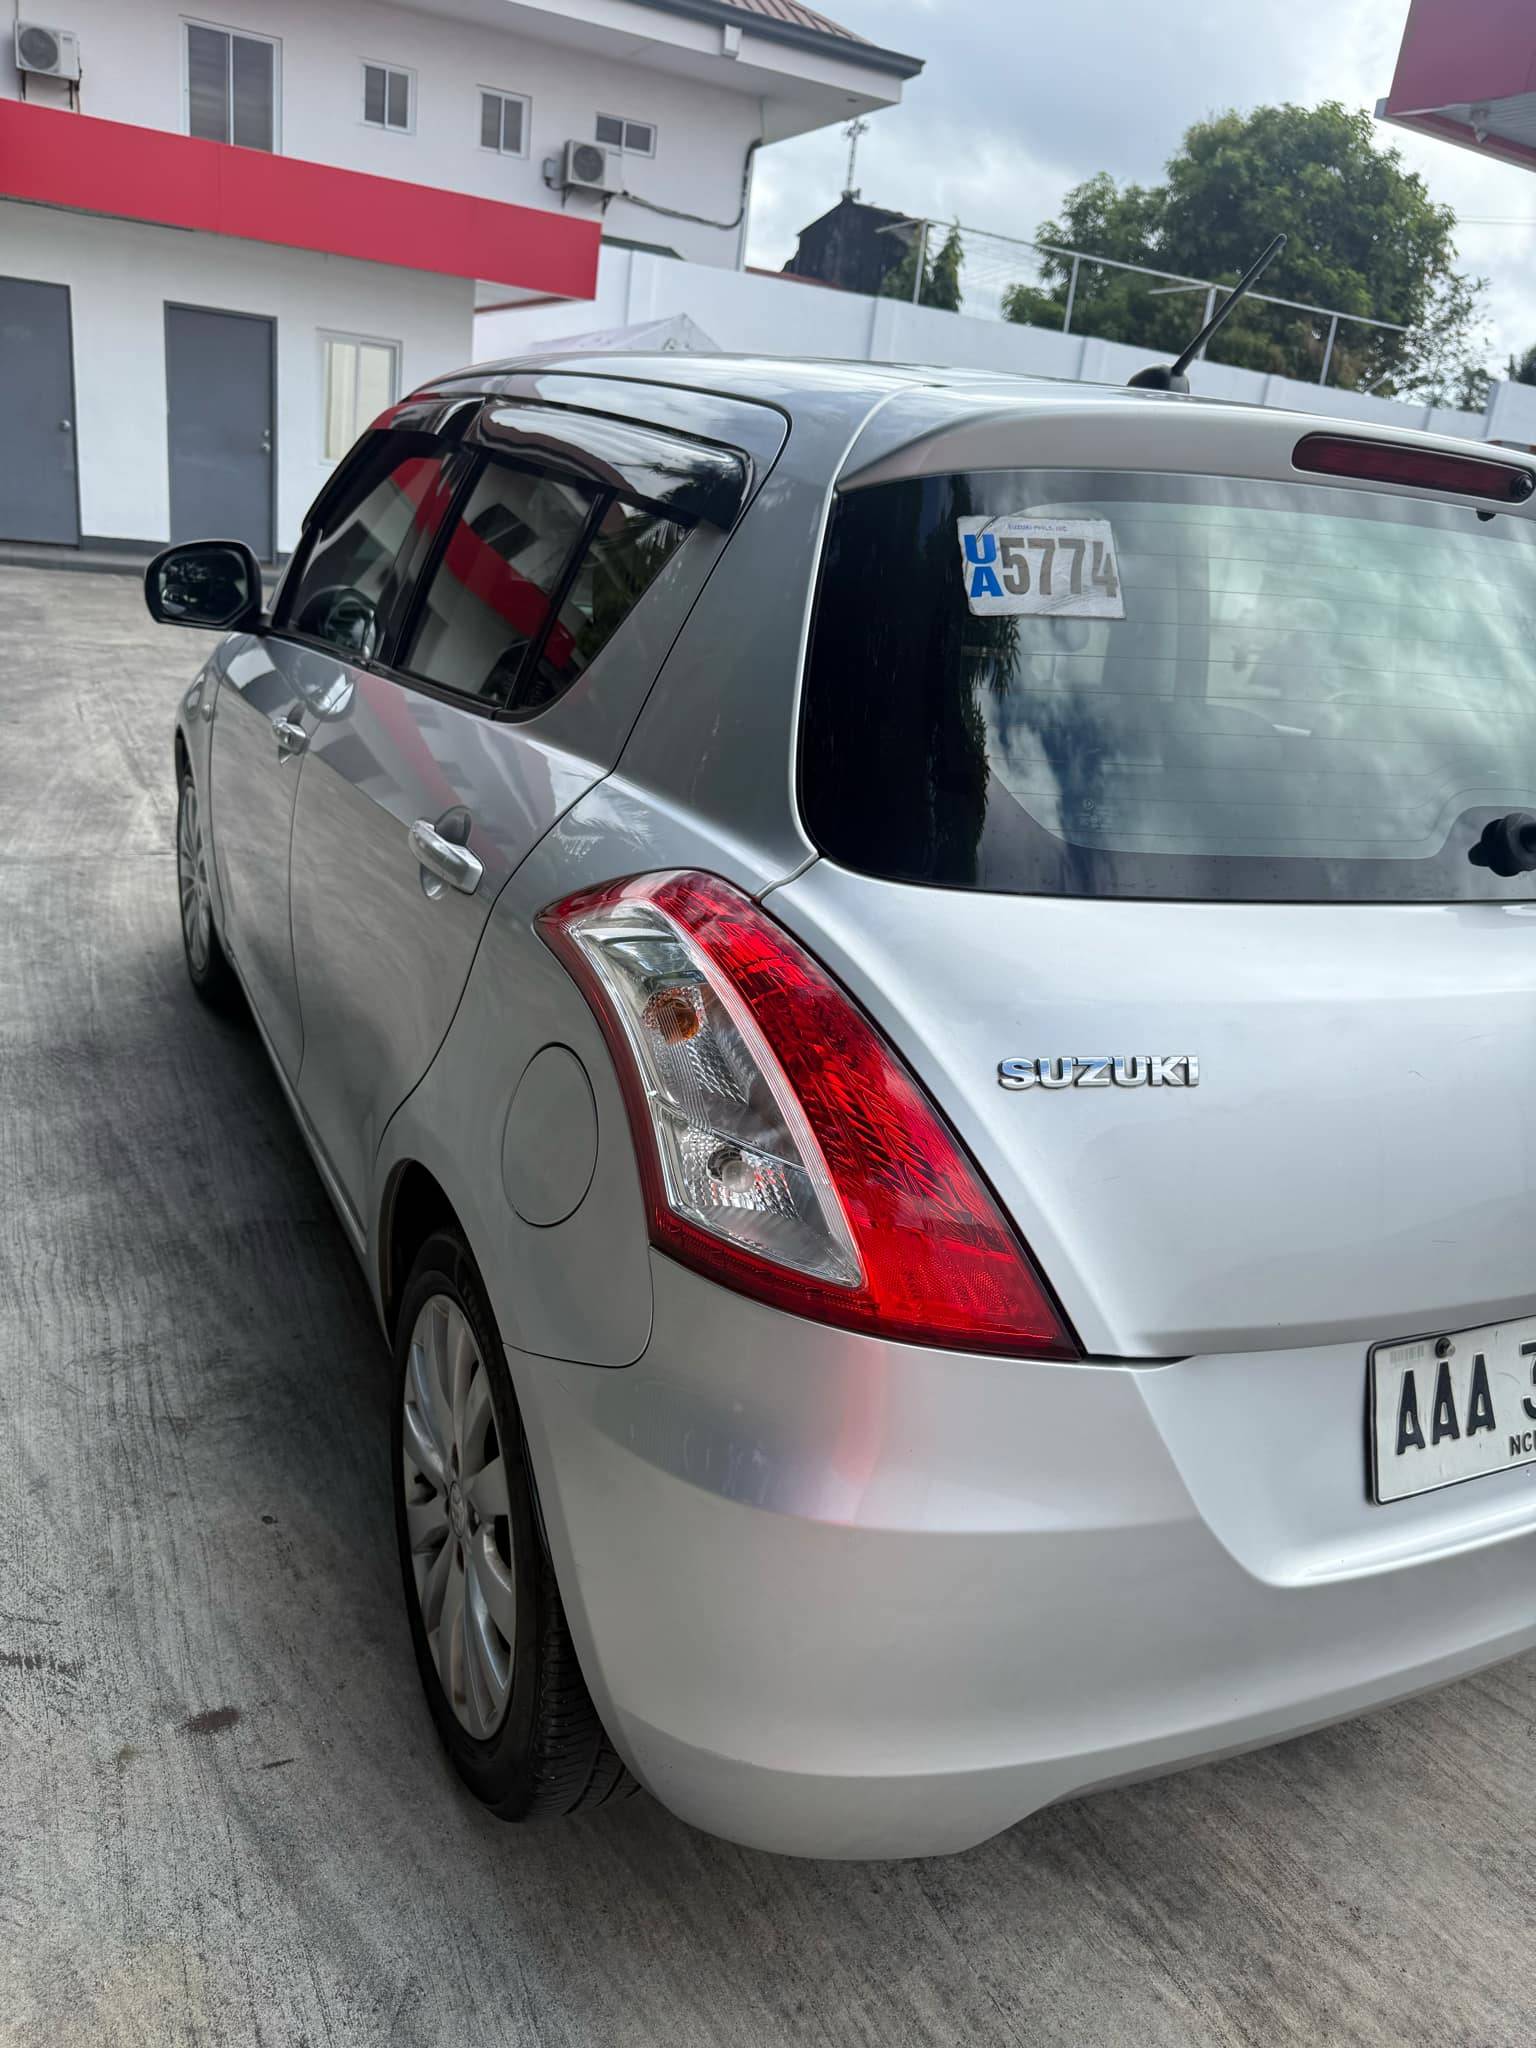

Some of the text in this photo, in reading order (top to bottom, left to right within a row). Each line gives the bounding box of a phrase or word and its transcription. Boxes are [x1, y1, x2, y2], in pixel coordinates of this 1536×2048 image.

[999, 536, 1119, 598] 5774
[998, 1056, 1200, 1091] SUZUKI
[1396, 1352, 1497, 1456] AAA
